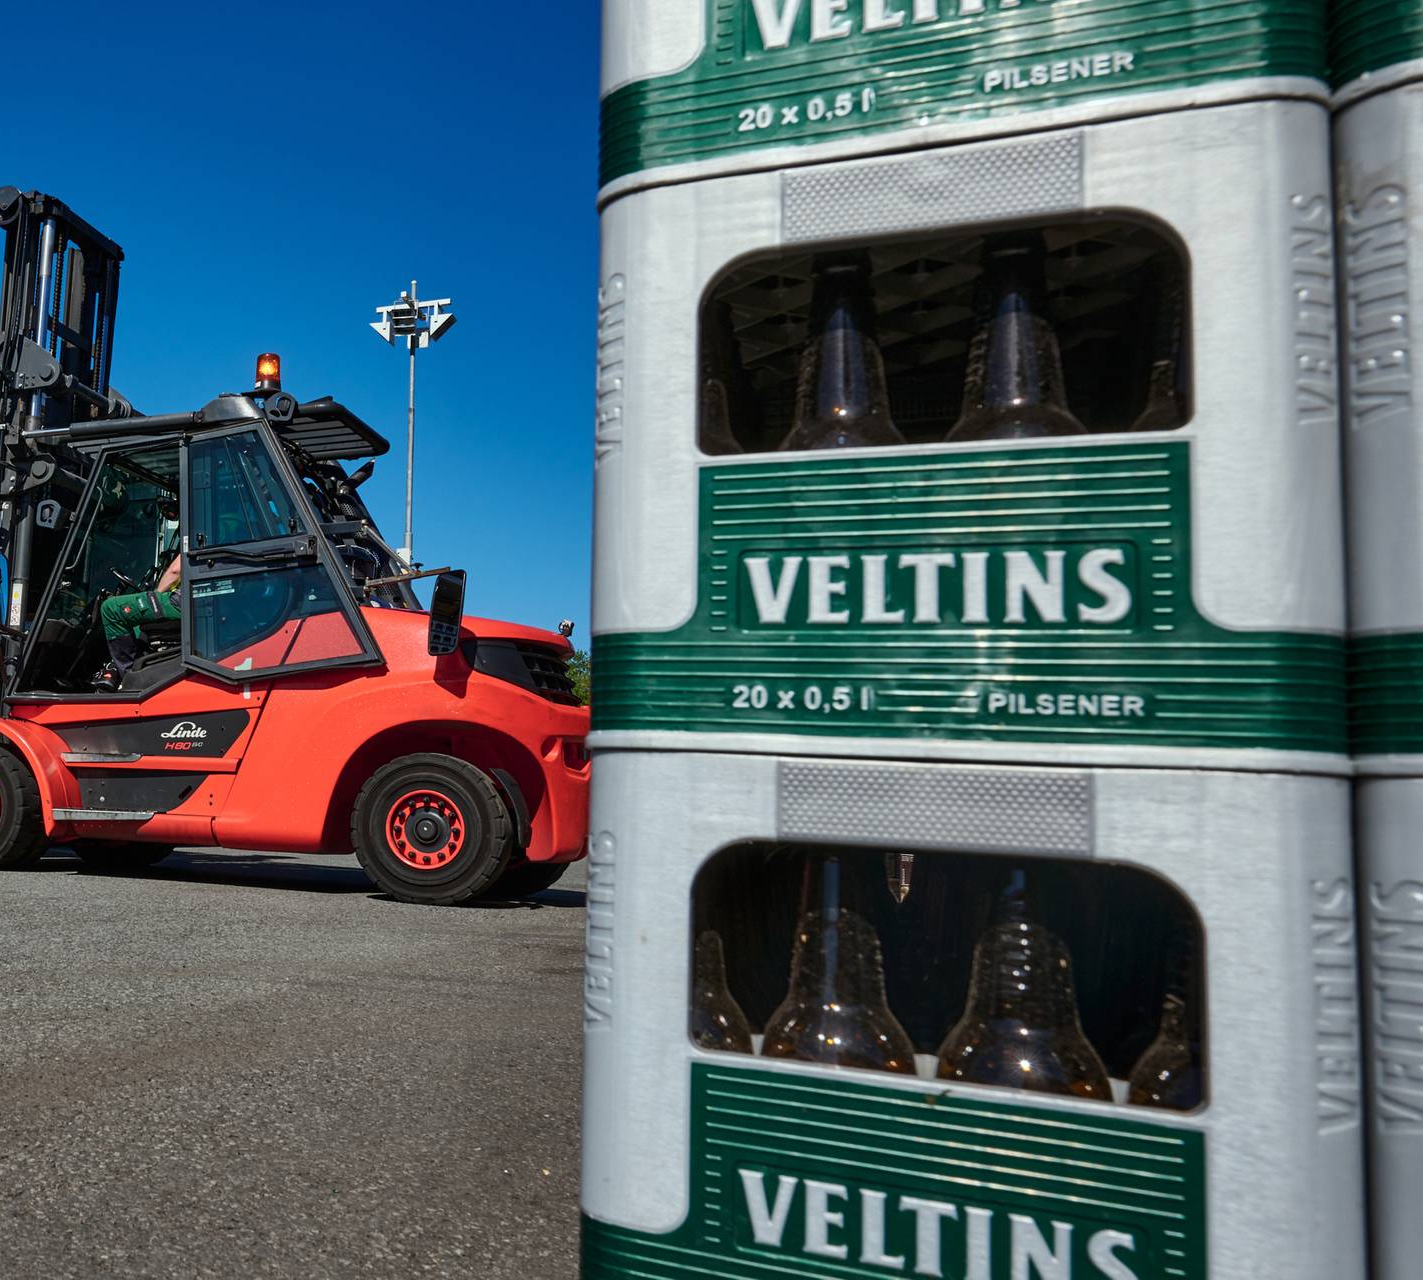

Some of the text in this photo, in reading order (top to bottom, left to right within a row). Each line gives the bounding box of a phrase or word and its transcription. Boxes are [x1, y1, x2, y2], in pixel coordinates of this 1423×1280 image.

[982, 51, 1136, 94] PILSENER
[737, 107, 773, 133] 20
[781, 107, 800, 126] x
[806, 92, 853, 123] 0,5
[1290, 194, 1335, 425] VELTINS
[1345, 183, 1411, 430] VELTINS
[742, 547, 1132, 625] VELTINS
[161, 721, 207, 738] Linde
[731, 684, 769, 711] 20
[777, 690, 795, 710] x
[803, 685, 851, 715] 0,5
[988, 690, 1147, 718] PILSENER
[584, 829, 618, 1032] VELTINS
[1310, 877, 1360, 1137] VELTINS
[737, 1169, 1140, 1280] VELTINS
